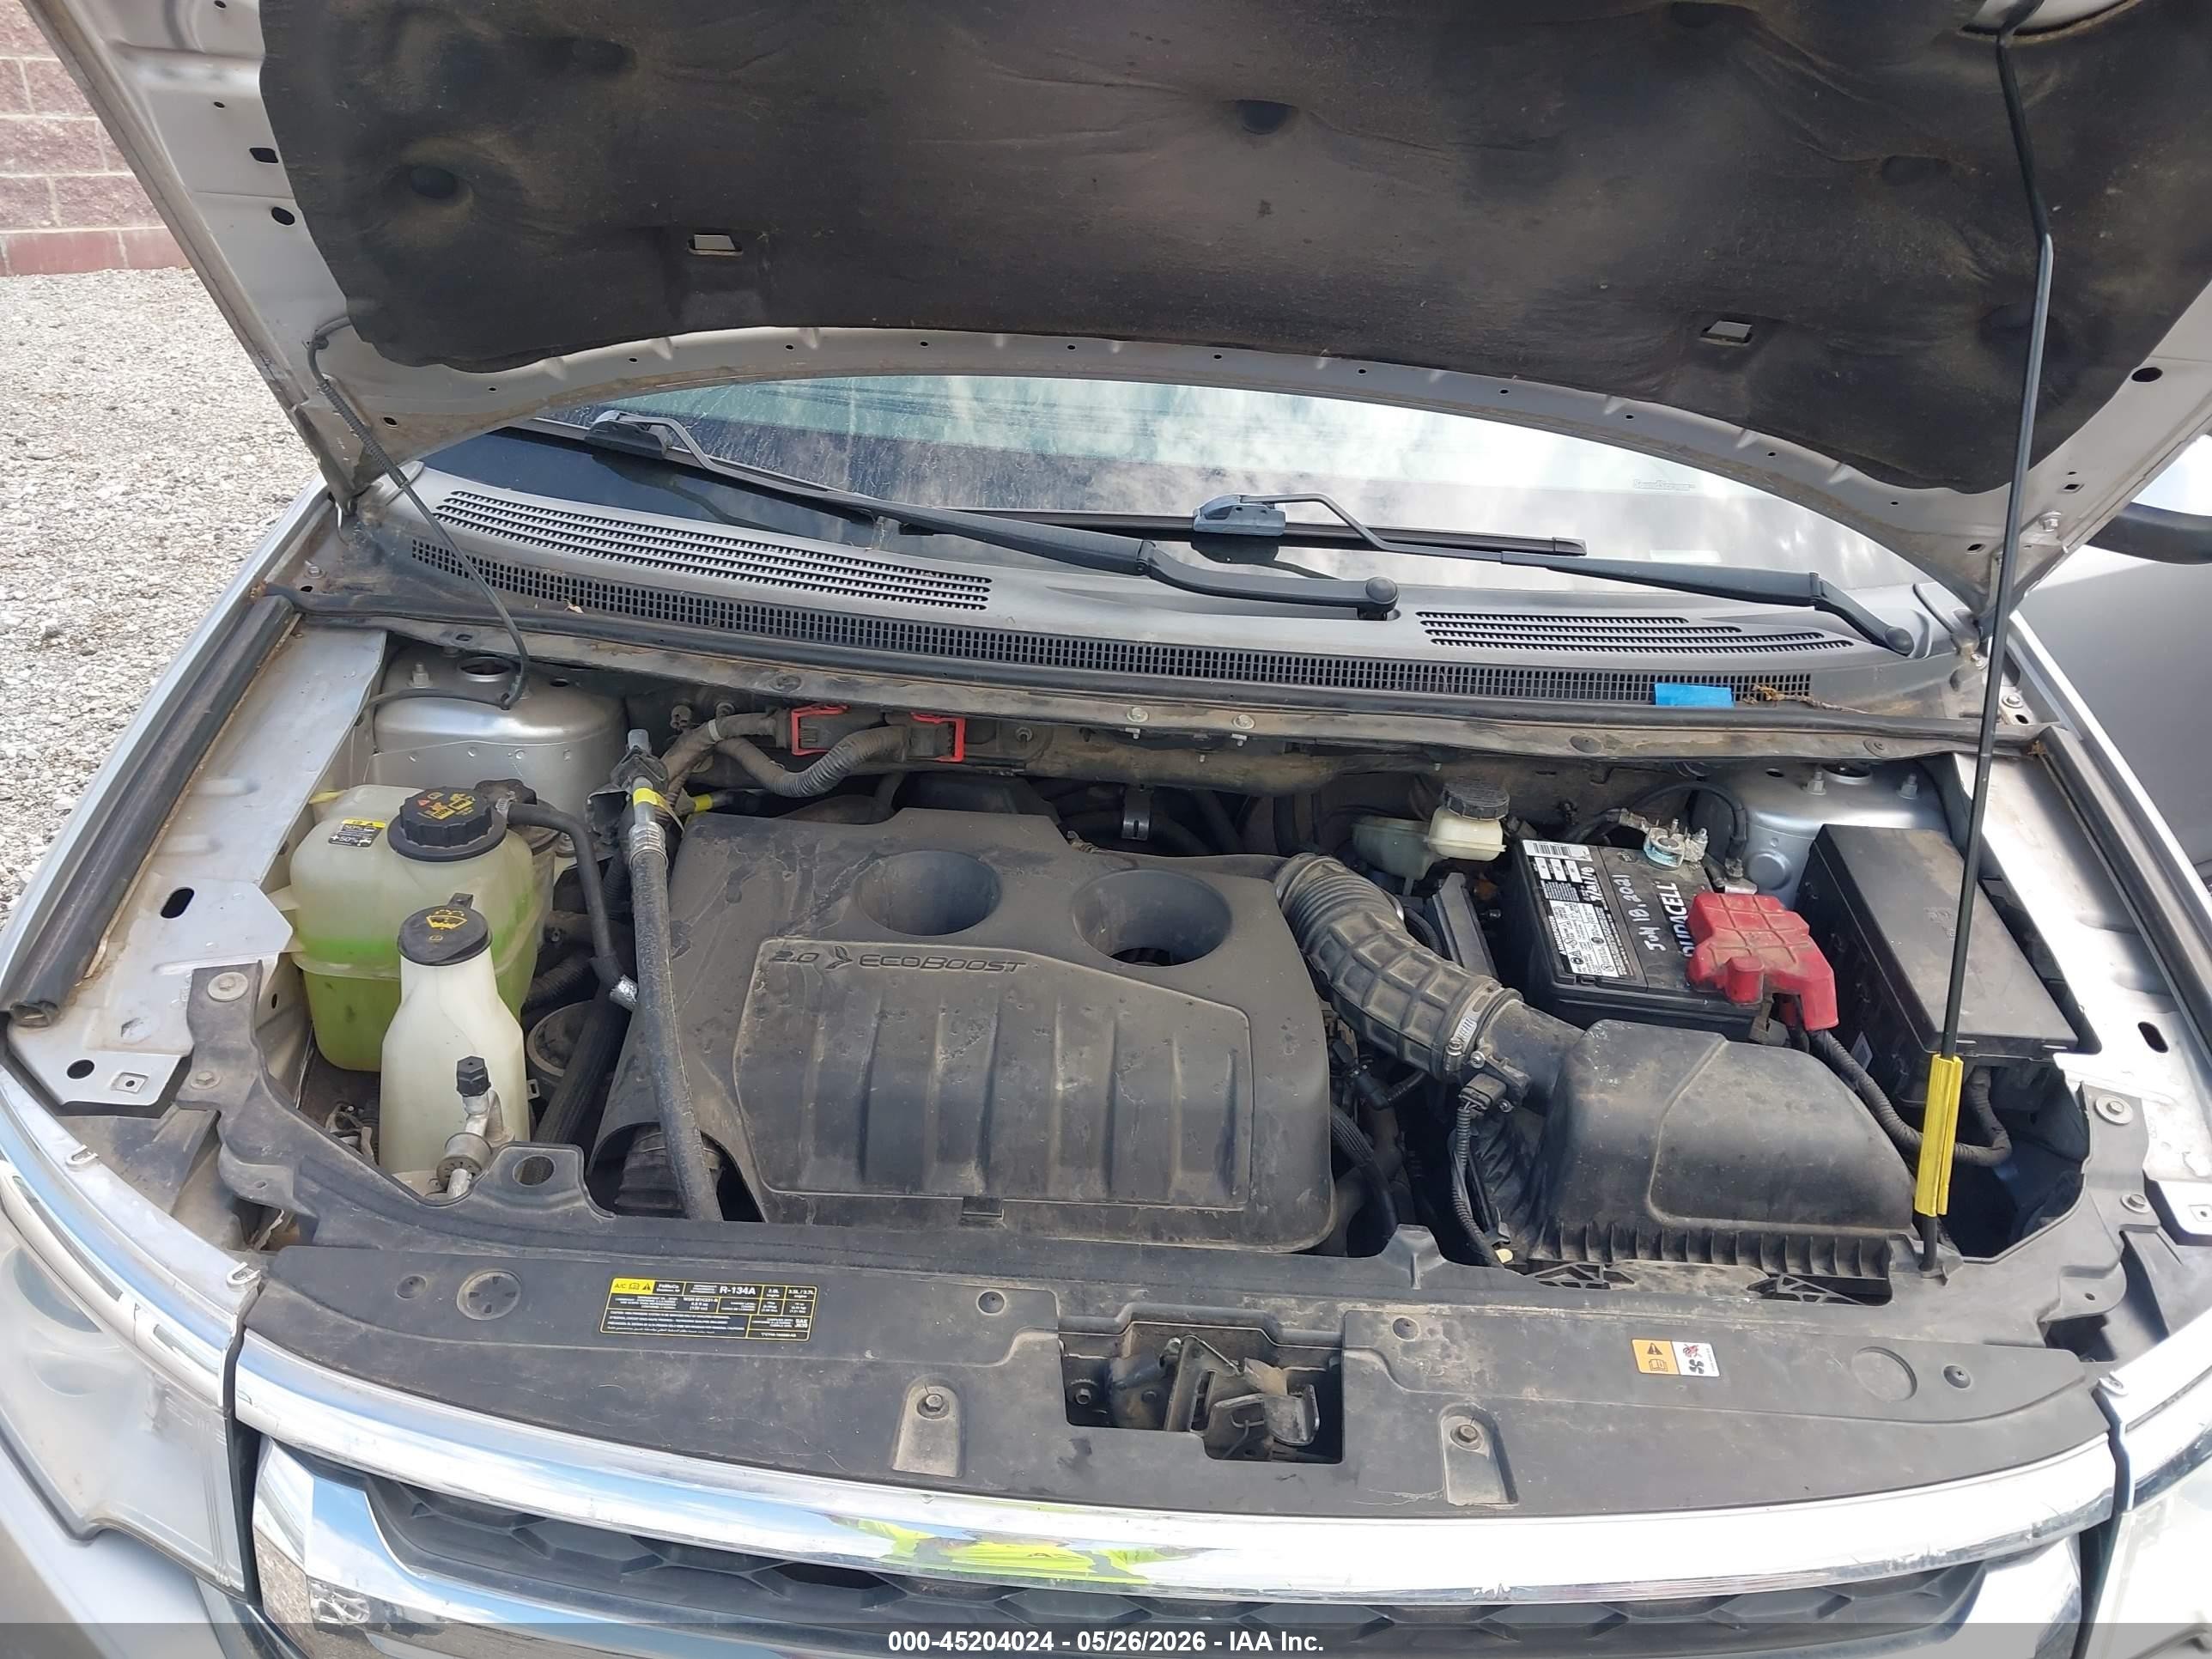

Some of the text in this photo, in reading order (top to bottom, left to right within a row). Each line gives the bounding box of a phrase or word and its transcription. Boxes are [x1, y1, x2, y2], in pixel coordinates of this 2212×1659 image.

[1612, 874, 1641, 902] 2021
[767, 950, 820, 963] 2.0
[719, 1285, 756, 1295] R-134A
